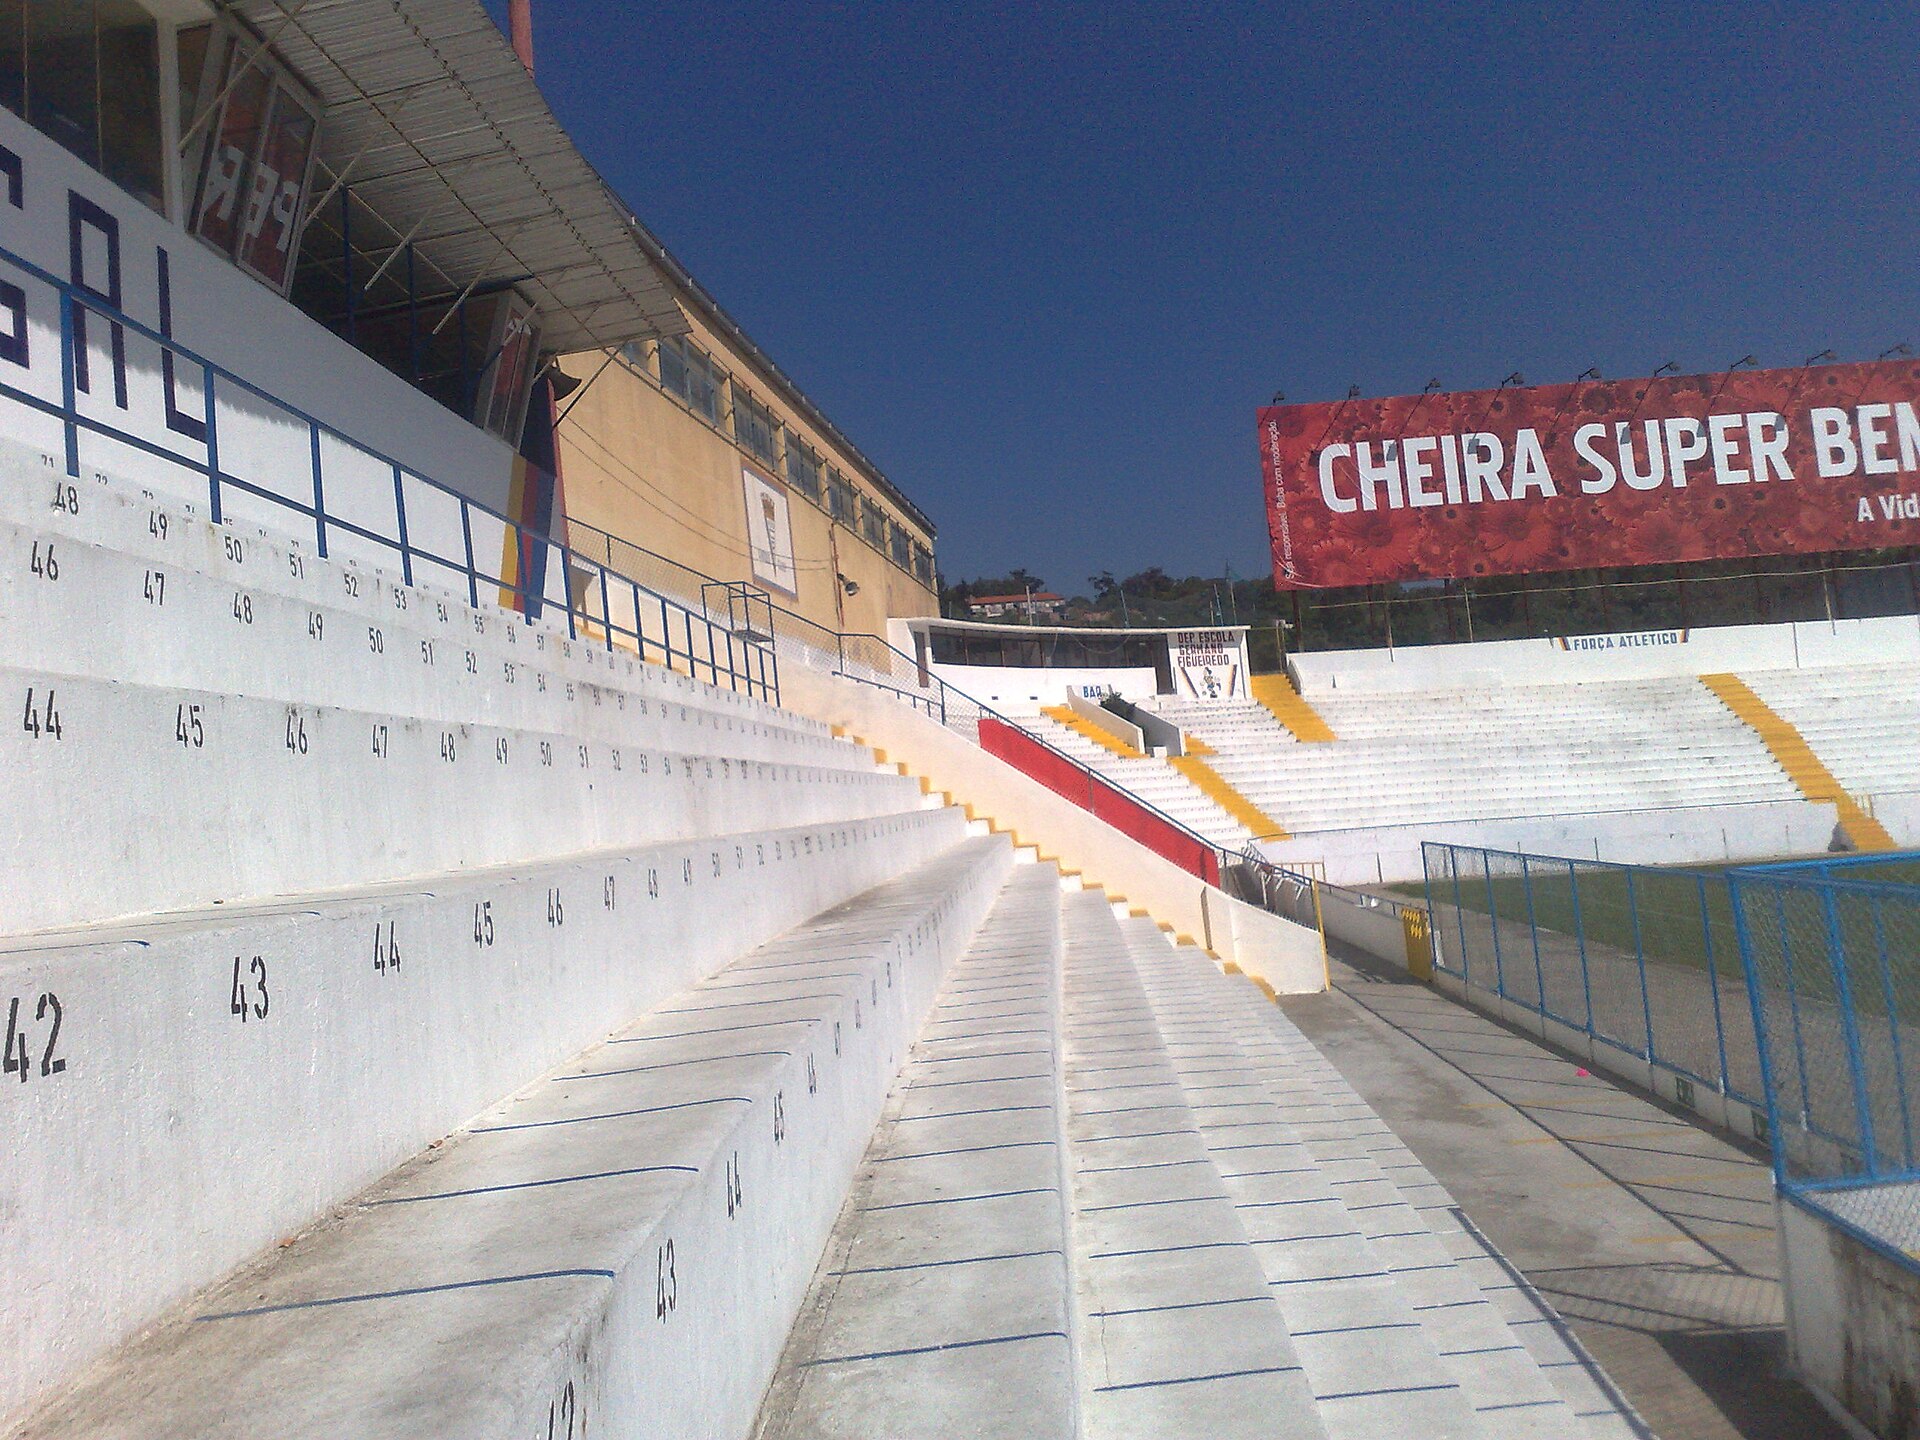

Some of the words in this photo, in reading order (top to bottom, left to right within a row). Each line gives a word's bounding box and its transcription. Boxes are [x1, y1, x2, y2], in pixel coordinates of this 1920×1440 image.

[1319, 428, 1558, 513] CHEIRA
[1573, 411, 1796, 495] SUPER
[53, 482, 79, 515] 48
[149, 511, 168, 540] 49
[224, 536, 243, 564] 50
[289, 553, 304, 579] 51
[344, 573, 359, 598] 52
[394, 588, 407, 610] 53
[1858, 496, 1875, 522] A
[31, 541, 59, 581] 46
[143, 570, 165, 605] 47
[233, 592, 253, 624] 48
[308, 611, 323, 641] 49
[369, 626, 384, 654] 50
[421, 640, 434, 666] 51
[465, 650, 478, 674] 52
[504, 662, 515, 684] 53
[1199, 630, 1235, 643] ESCOLA
[1573, 636, 1615, 652] FORÇA
[1177, 654, 1230, 667] FIGUEIREDO
[23, 687, 62, 741] 44
[176, 703, 204, 749] 45
[286, 714, 309, 755] 46
[372, 724, 388, 758] 47
[440, 731, 456, 762] 48
[496, 737, 508, 764] 49
[540, 741, 552, 766] 50
[2, 991, 67, 1083] 42
[231, 955, 270, 1023] 43
[374, 920, 401, 977] 44
[474, 900, 494, 949] 45
[547, 887, 563, 928] 46
[604, 876, 615, 911] 47
[656, 1238, 677, 1324] 43
